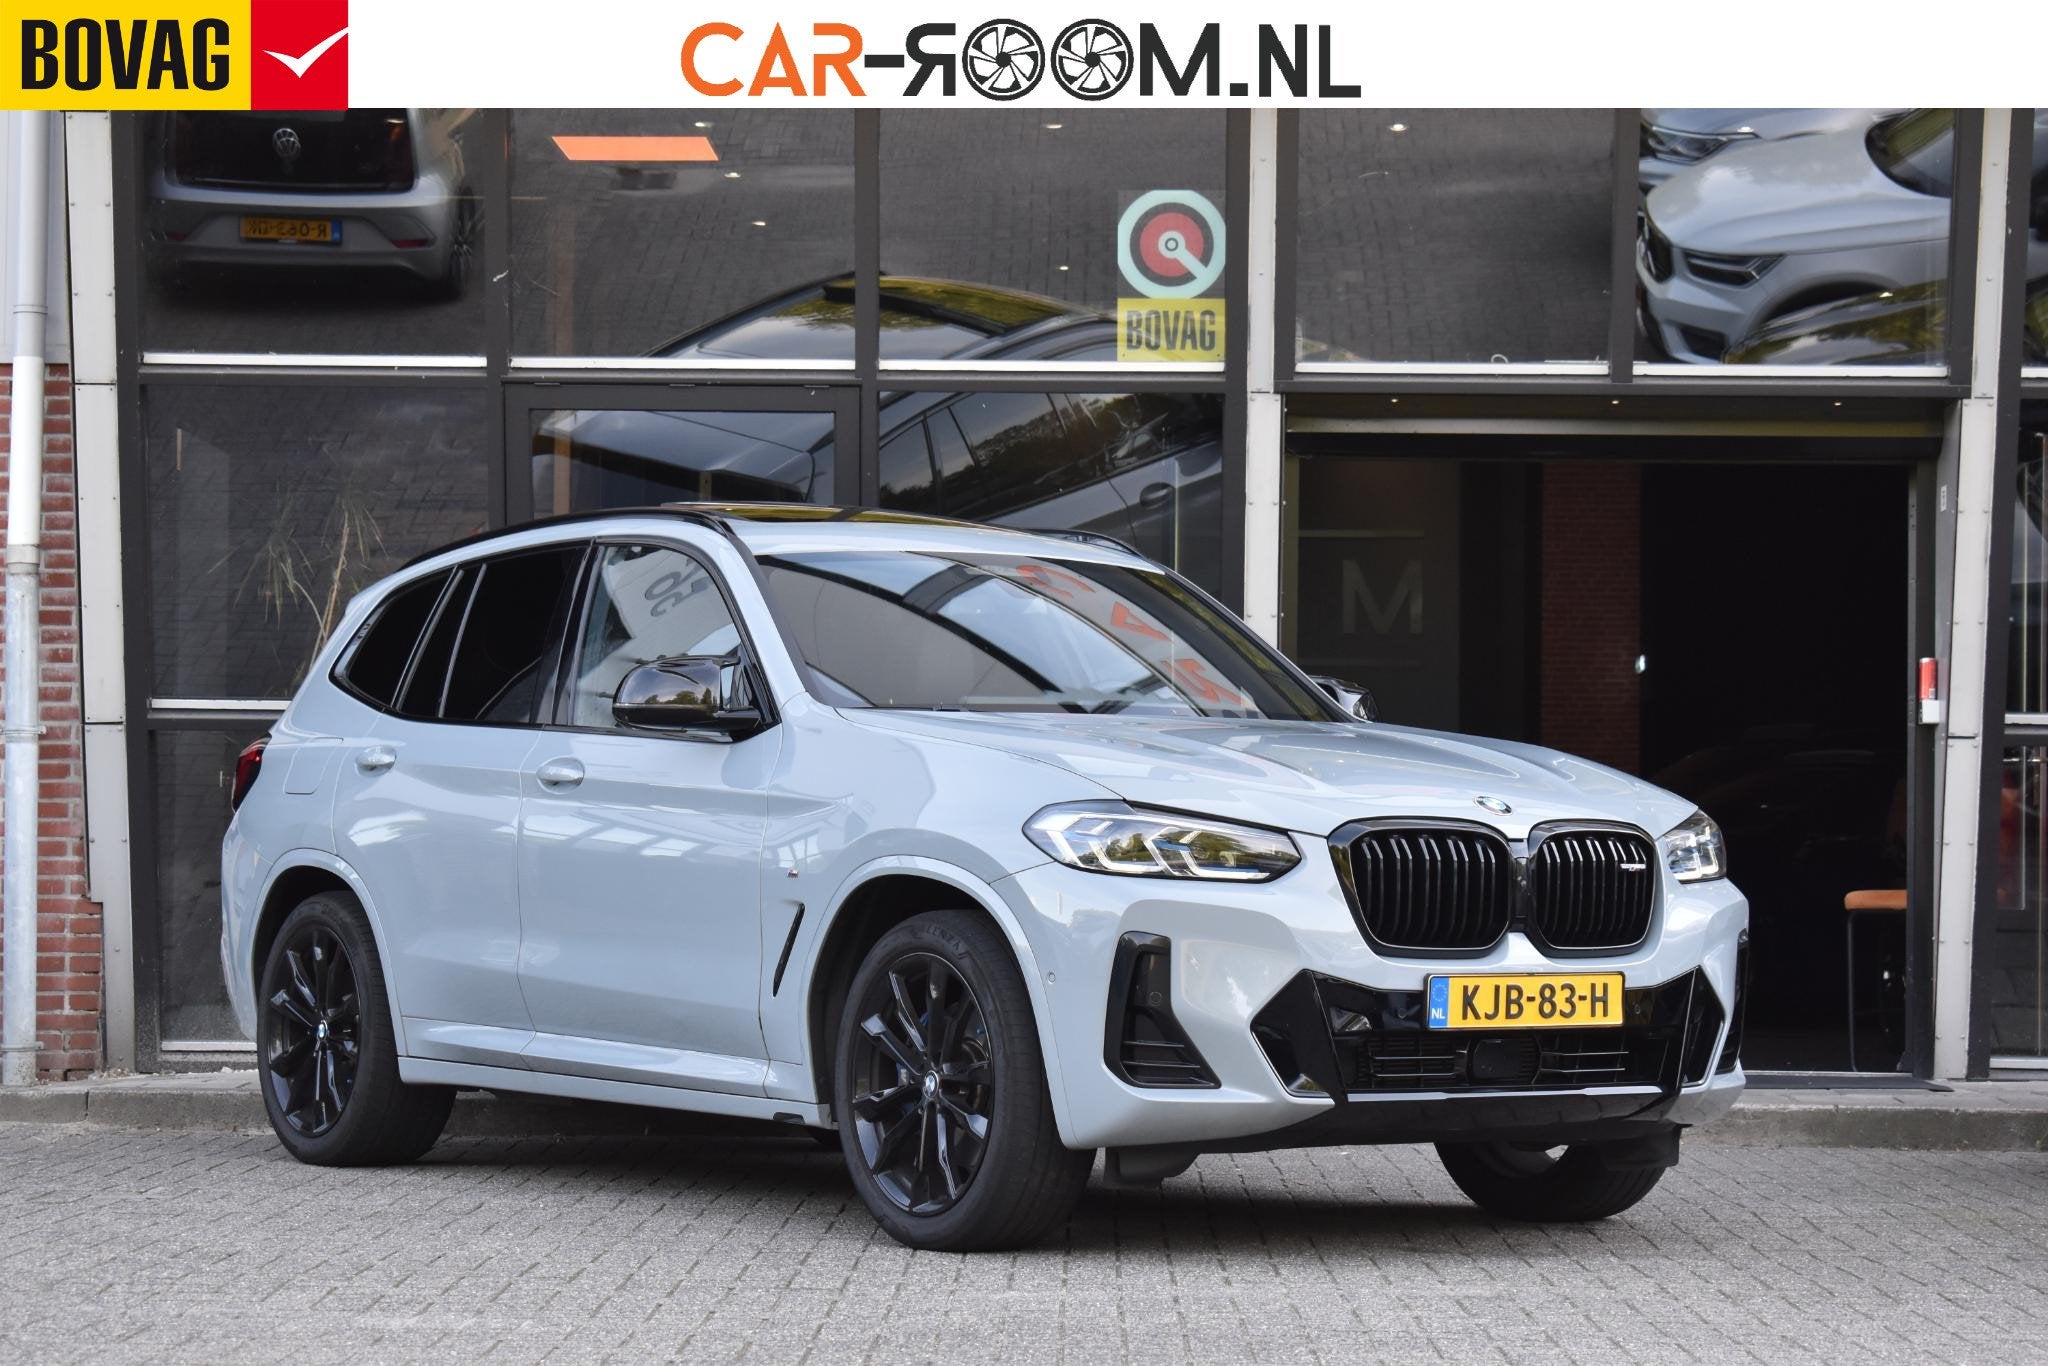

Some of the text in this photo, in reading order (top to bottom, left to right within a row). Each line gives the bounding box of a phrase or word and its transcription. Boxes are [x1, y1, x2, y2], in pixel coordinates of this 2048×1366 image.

[1126, 309, 1216, 351] BOVAG
[1431, 983, 1609, 1020] NL KJB-83-H
